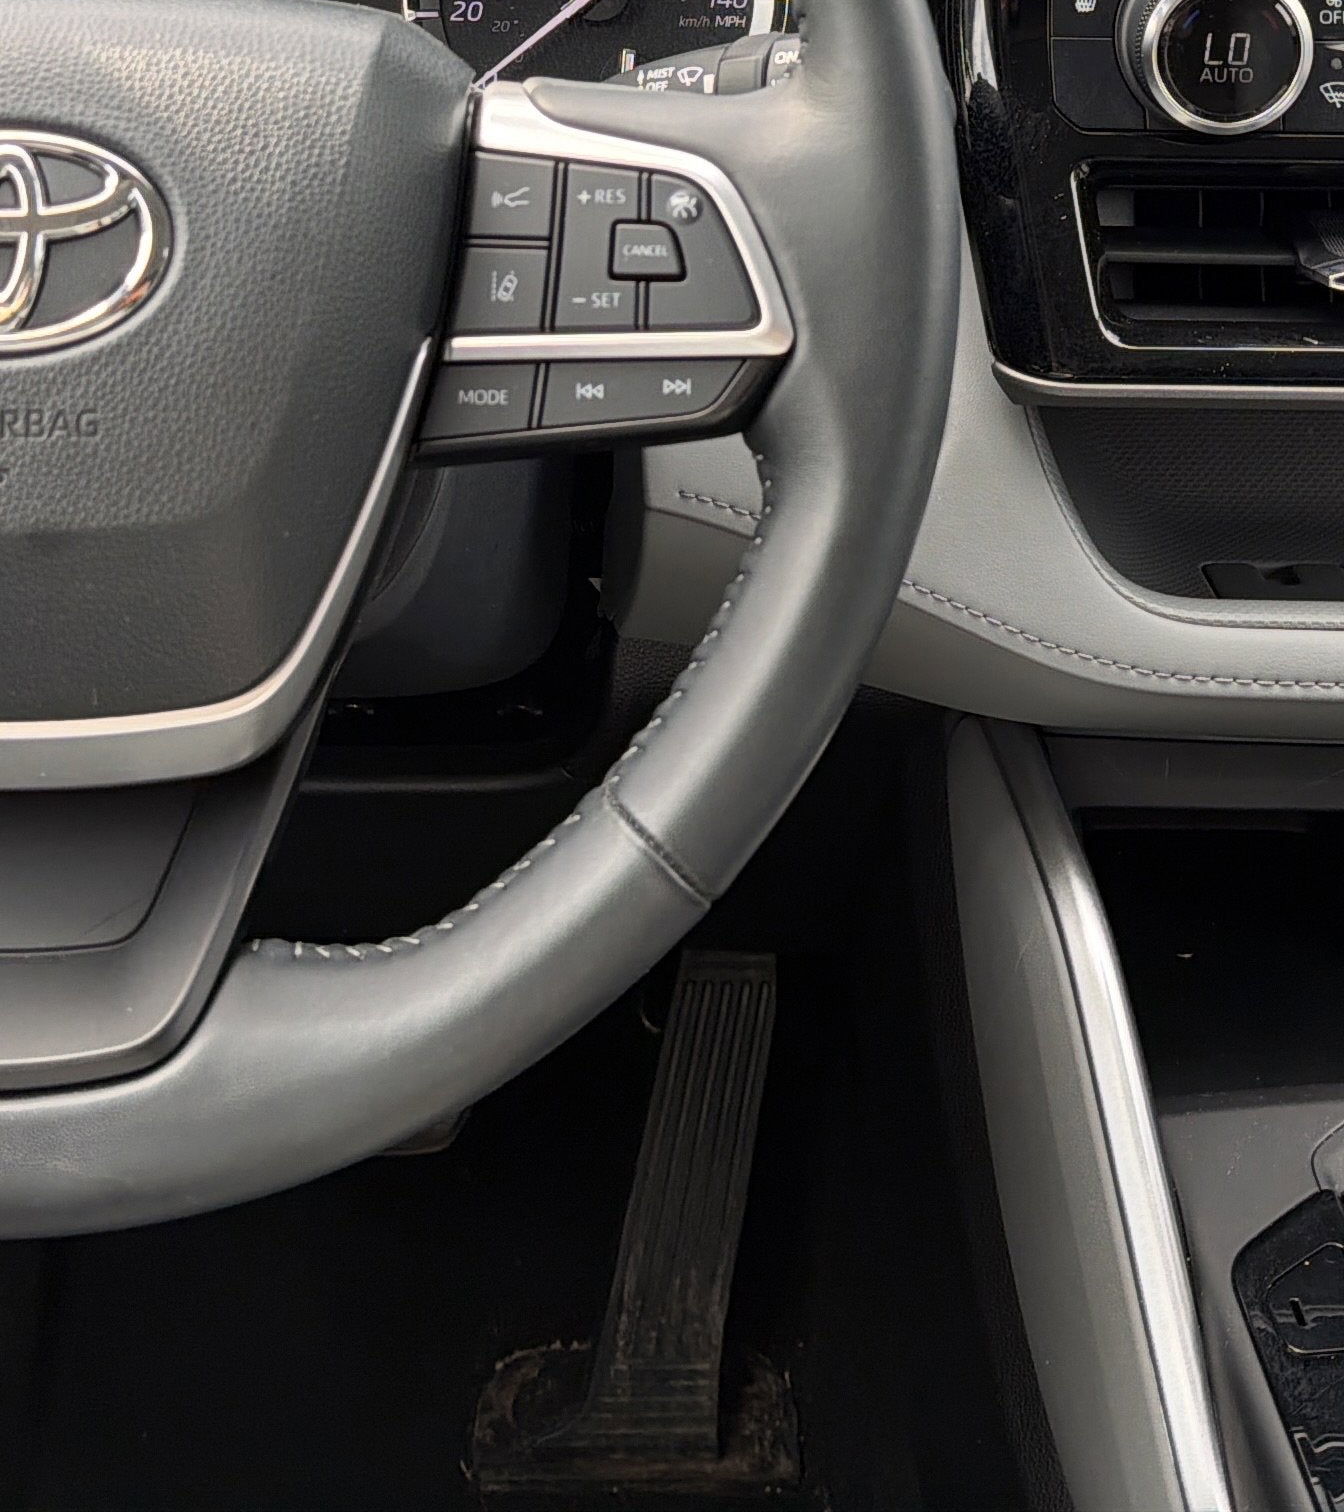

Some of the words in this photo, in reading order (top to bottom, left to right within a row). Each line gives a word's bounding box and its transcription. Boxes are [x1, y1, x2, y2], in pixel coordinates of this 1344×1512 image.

[450, 1, 484, 23] 20
[491, 20, 511, 33] 20
[678, 15, 710, 29] km/h
[714, 15, 746, 29] MPH
[1204, 32, 1250, 66] LO
[646, 67, 676, 80] MIST
[1200, 68, 1253, 84] AUTO
[646, 81, 669, 92] OFF
[623, 244, 668, 257] CANCEL
[459, 390, 509, 406] MODE
